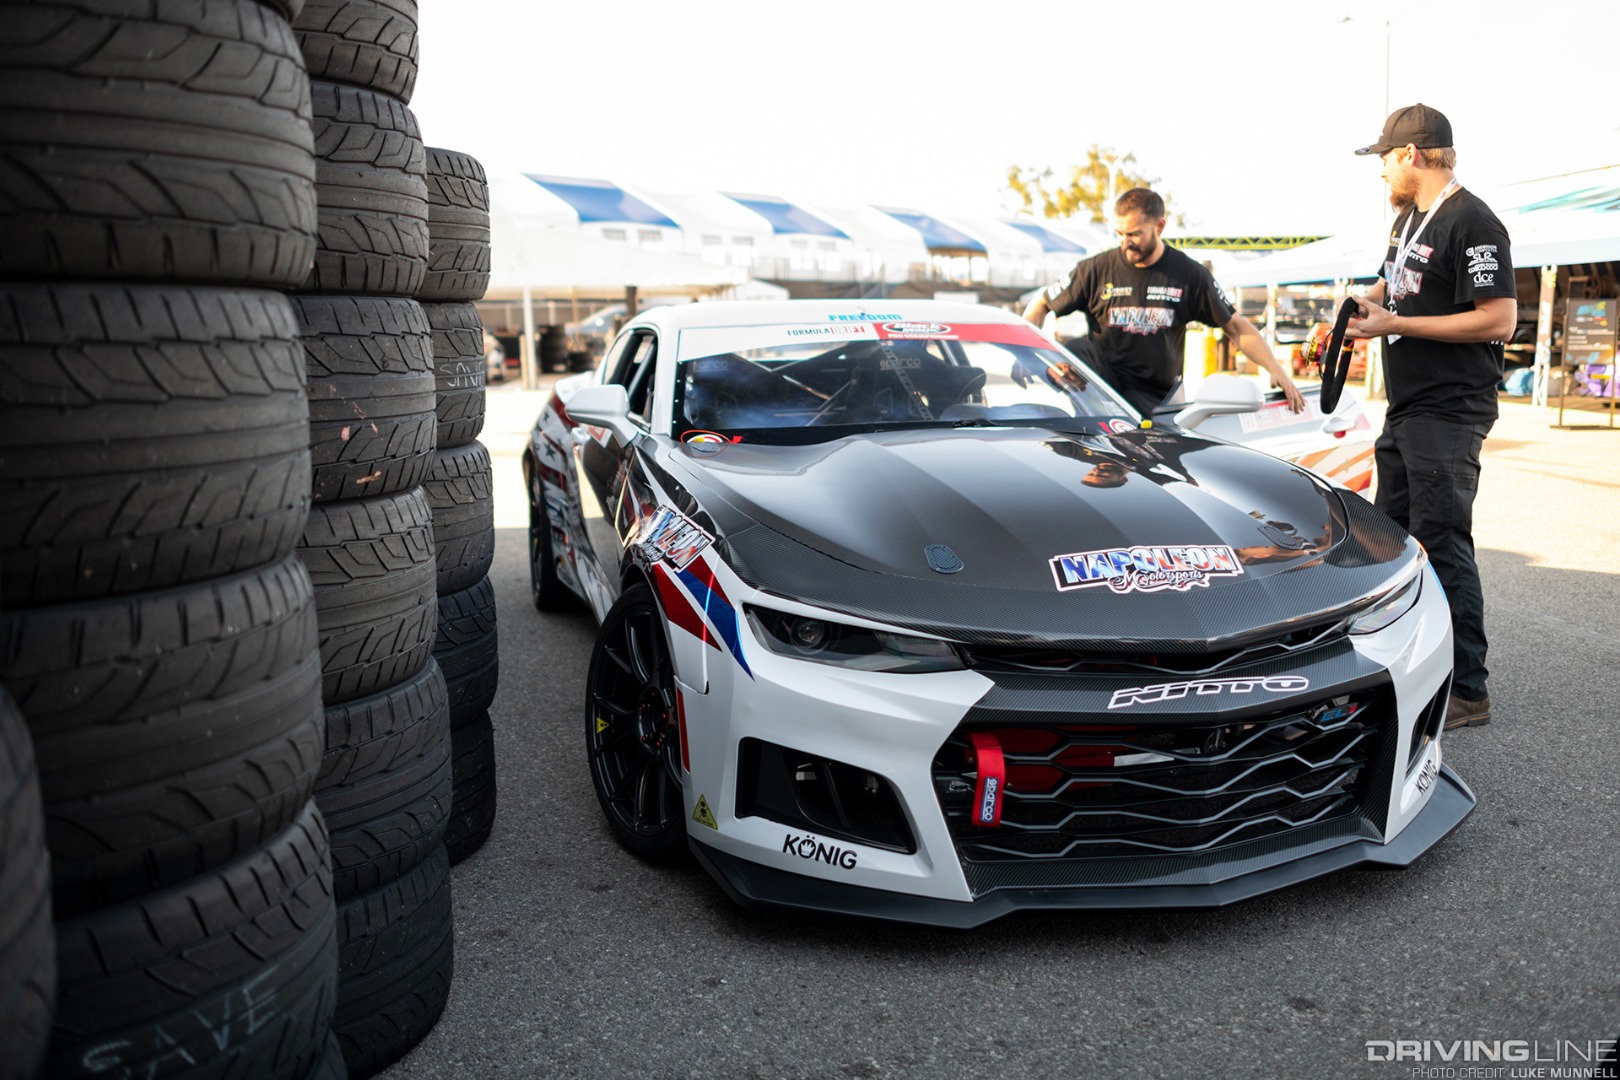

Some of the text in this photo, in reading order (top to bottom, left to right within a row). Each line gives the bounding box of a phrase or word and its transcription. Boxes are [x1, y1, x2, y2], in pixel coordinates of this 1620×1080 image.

[1473, 271, 1494, 283] dce
[787, 327, 830, 336] FORMULA
[1059, 547, 1237, 584] NAPOLEON
[1108, 569, 1206, 590] Motorsports
[1107, 676, 1309, 710] NITTO
[984, 778, 998, 821] sparco
[782, 834, 858, 870] KÖNIG
[83, 965, 281, 1080] SAVE
